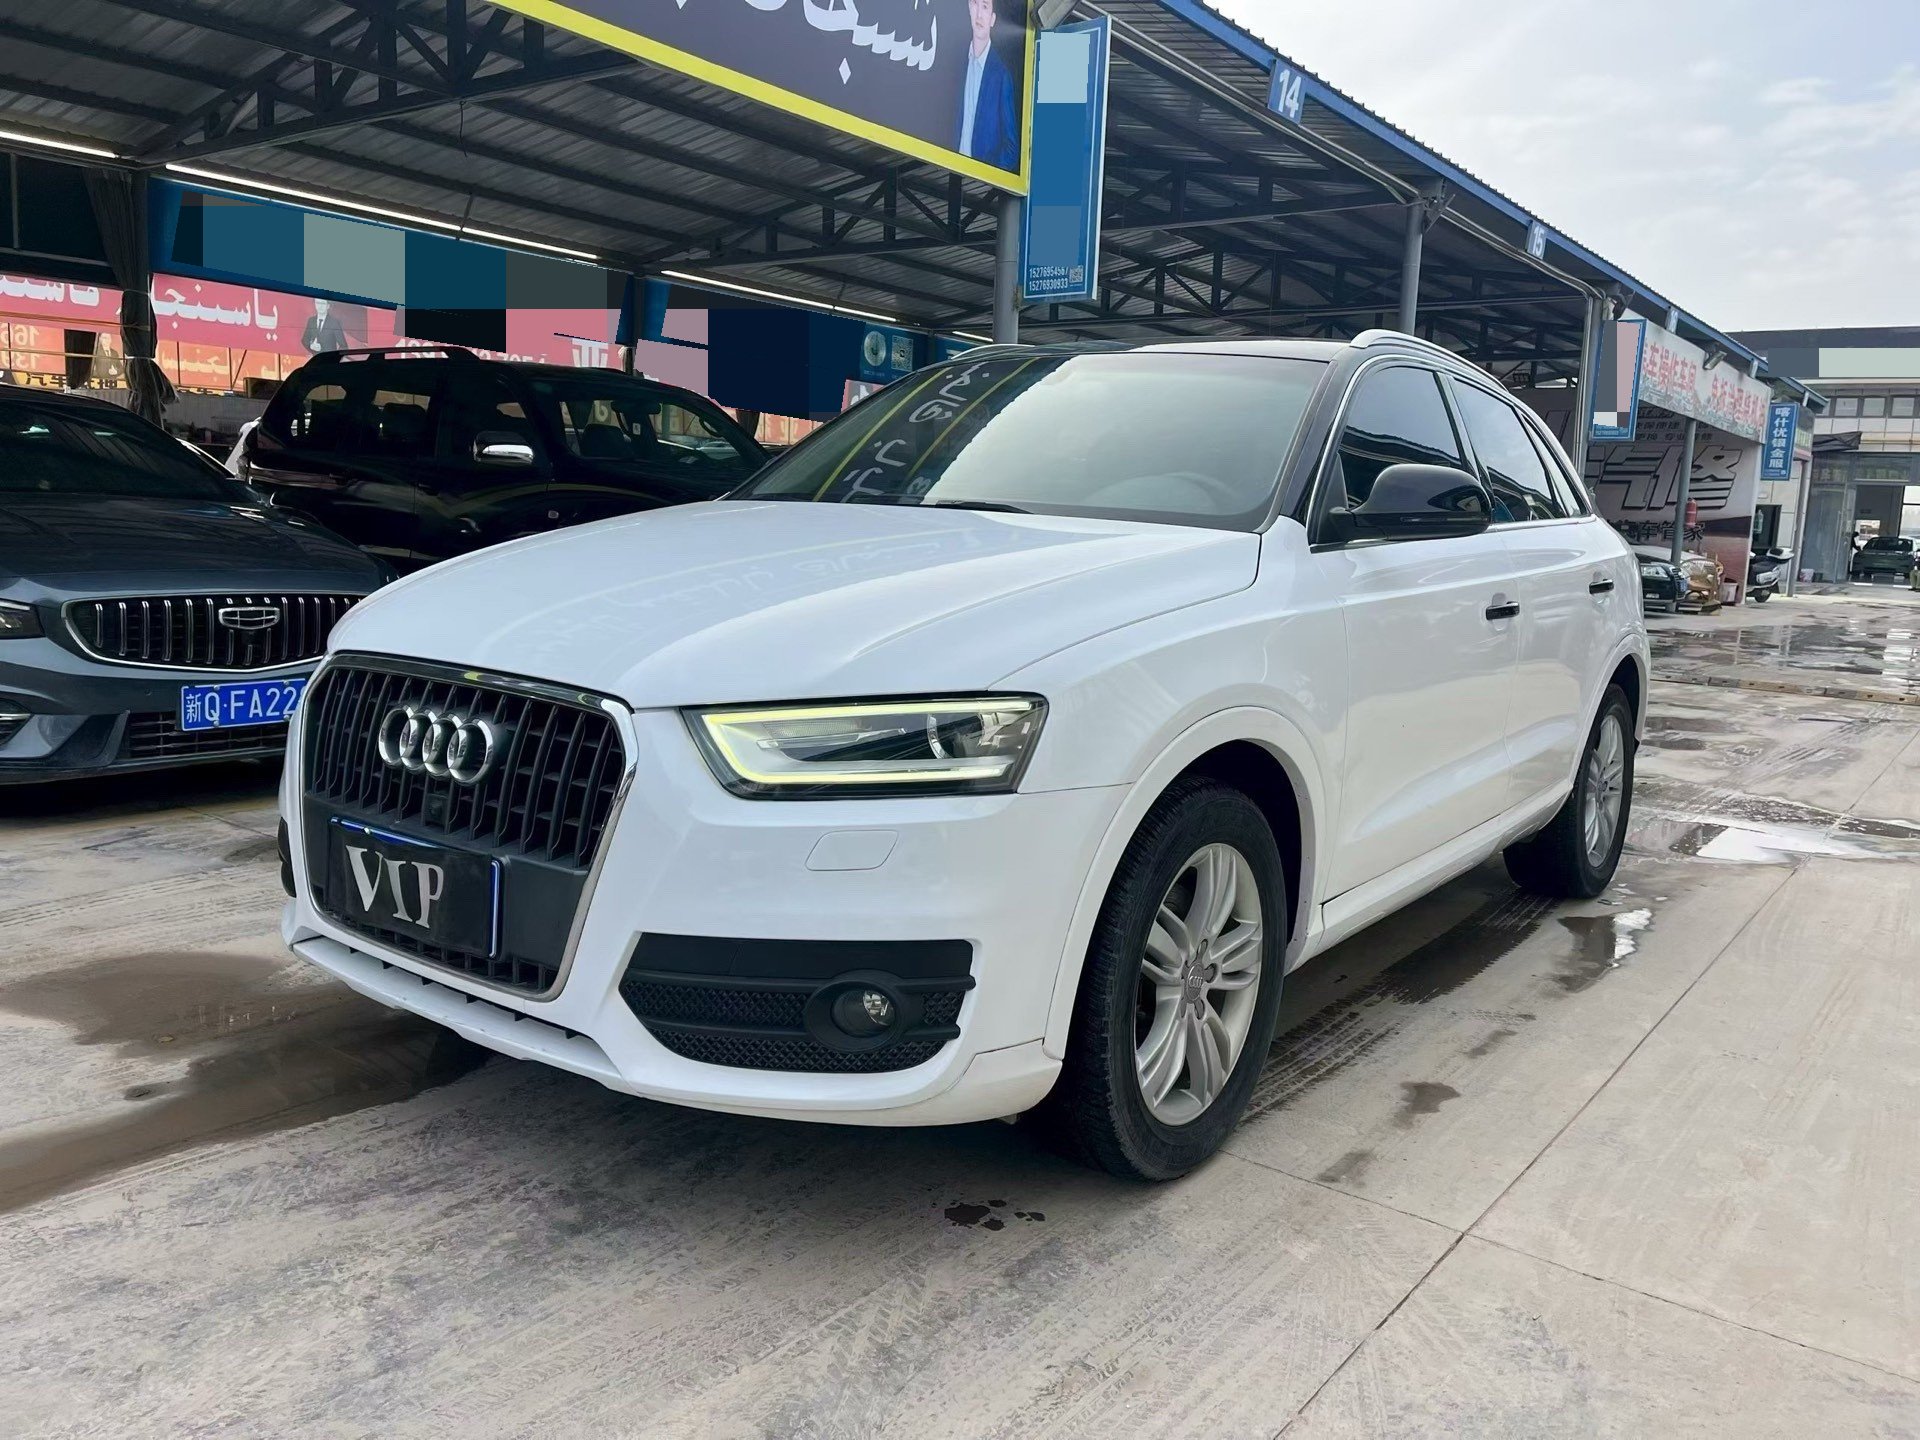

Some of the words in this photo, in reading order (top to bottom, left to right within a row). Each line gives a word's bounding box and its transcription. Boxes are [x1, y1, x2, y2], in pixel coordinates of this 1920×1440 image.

[1278, 69, 1302, 119] 14
[1532, 225, 1545, 257] 15
[345, 844, 445, 929] VIP
